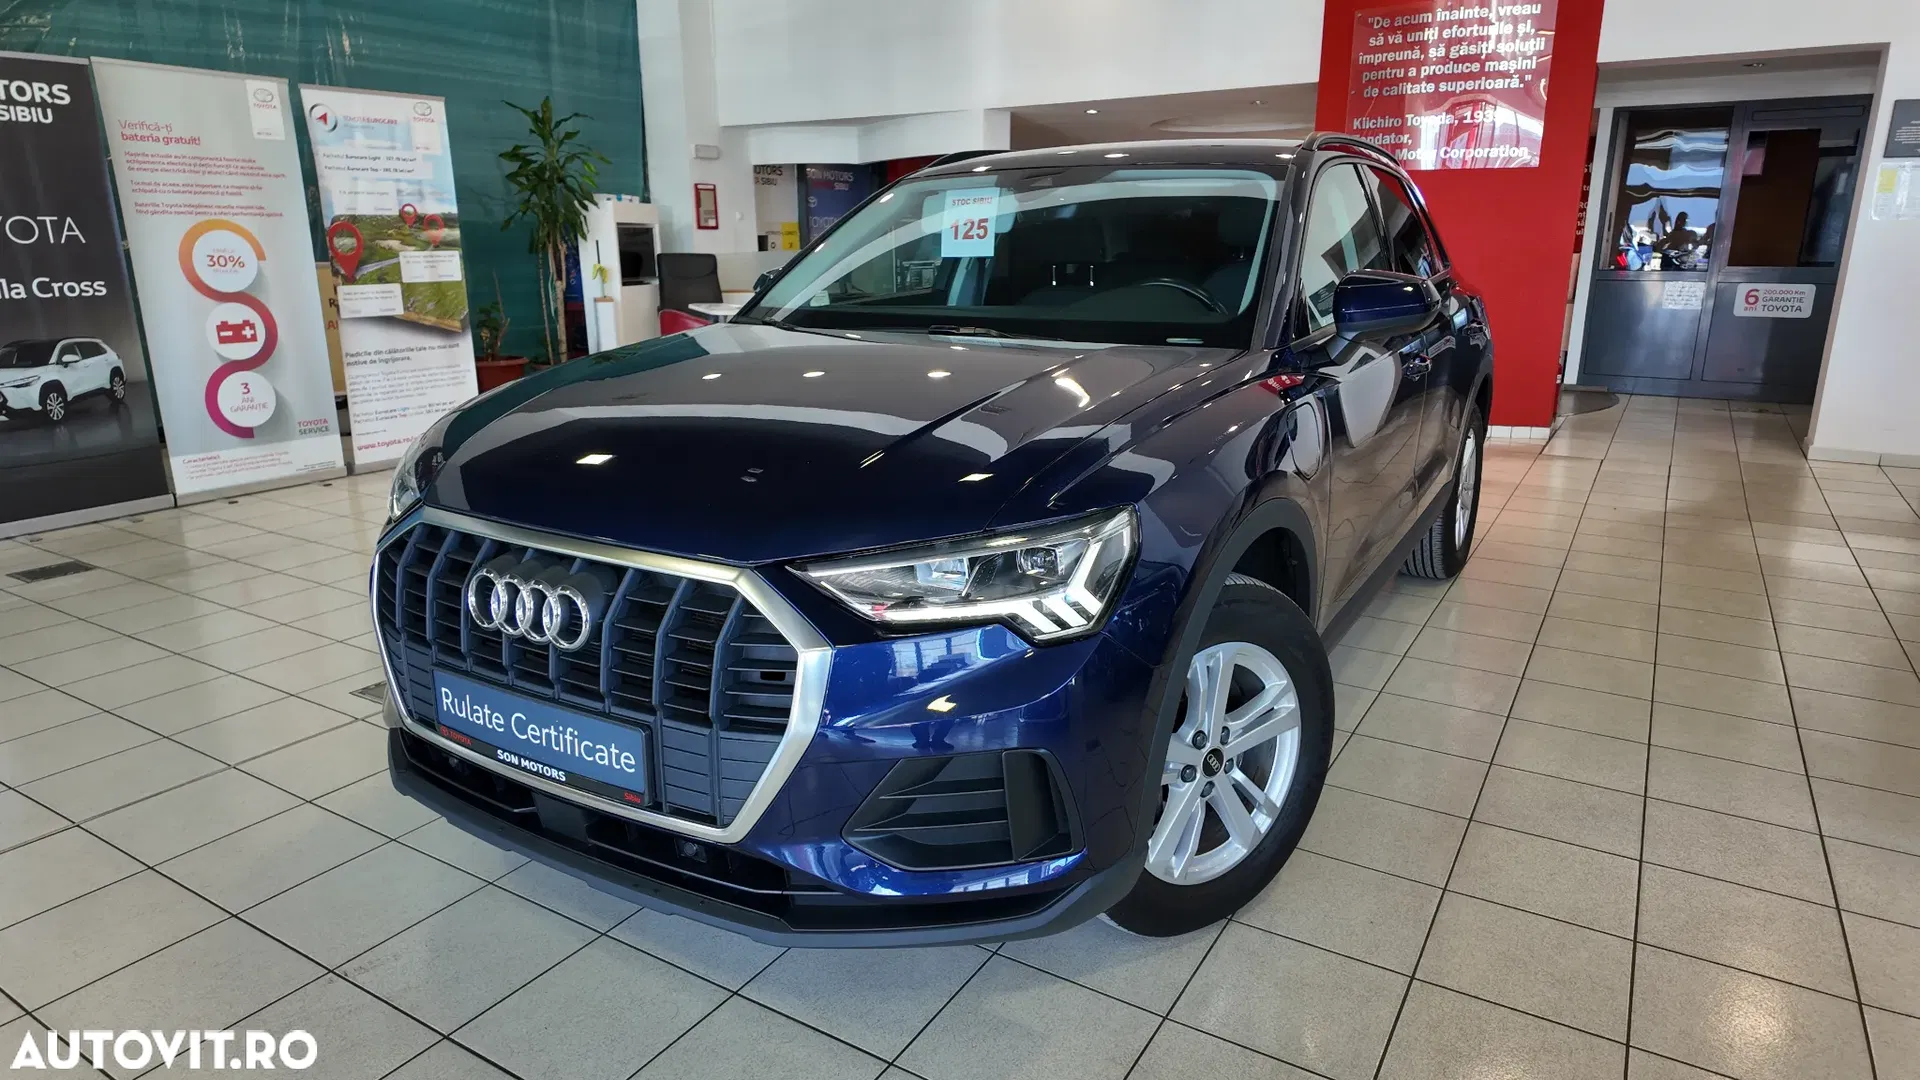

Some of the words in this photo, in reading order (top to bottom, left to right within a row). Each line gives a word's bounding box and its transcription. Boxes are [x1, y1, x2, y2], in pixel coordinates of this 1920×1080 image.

[1368, 16, 1391, 29] "De
[1394, 12, 1433, 25] acum
[1436, 6, 1495, 21] înainte,
[1498, 4, 1541, 17] vreau
[1369, 32, 1384, 46] să
[1388, 30, 1402, 44] vă
[1359, 46, 1424, 65] împreună,
[1362, 66, 1404, 82] pentru
[1408, 67, 1417, 77] a
[1421, 61, 1480, 78] produce
[1364, 84, 1379, 98] de
[1382, 79, 1435, 96] calitate
[1438, 75, 1532, 92] superioară."
[0, 104, 54, 124] SIBIU
[1353, 115, 1402, 130] Kiichiro
[1405, 112, 1459, 130] Toyda,
[1463, 109, 1500, 124] 193
[121, 131, 160, 143] bateria
[162, 136, 201, 146] gratuit!
[1440, 145, 1528, 160] Corporation
[0, 215, 87, 244] OTA
[950, 218, 989, 240] 125
[206, 254, 246, 268] 30%
[0, 277, 28, 299] la
[32, 276, 107, 298] Cross
[1744, 288, 1760, 306] 6
[1761, 304, 1802, 313] TOYOTA
[240, 382, 251, 395] 3
[297, 418, 329, 428] TOYOTA
[298, 426, 330, 436] SERVICE
[357, 435, 421, 451] www.toyota.ro/
[441, 687, 505, 732] Rulate
[511, 712, 636, 773] Certificate
[450, 731, 473, 745] TOYOTA
[497, 749, 519, 766] SON
[521, 758, 567, 782] MOTORS
